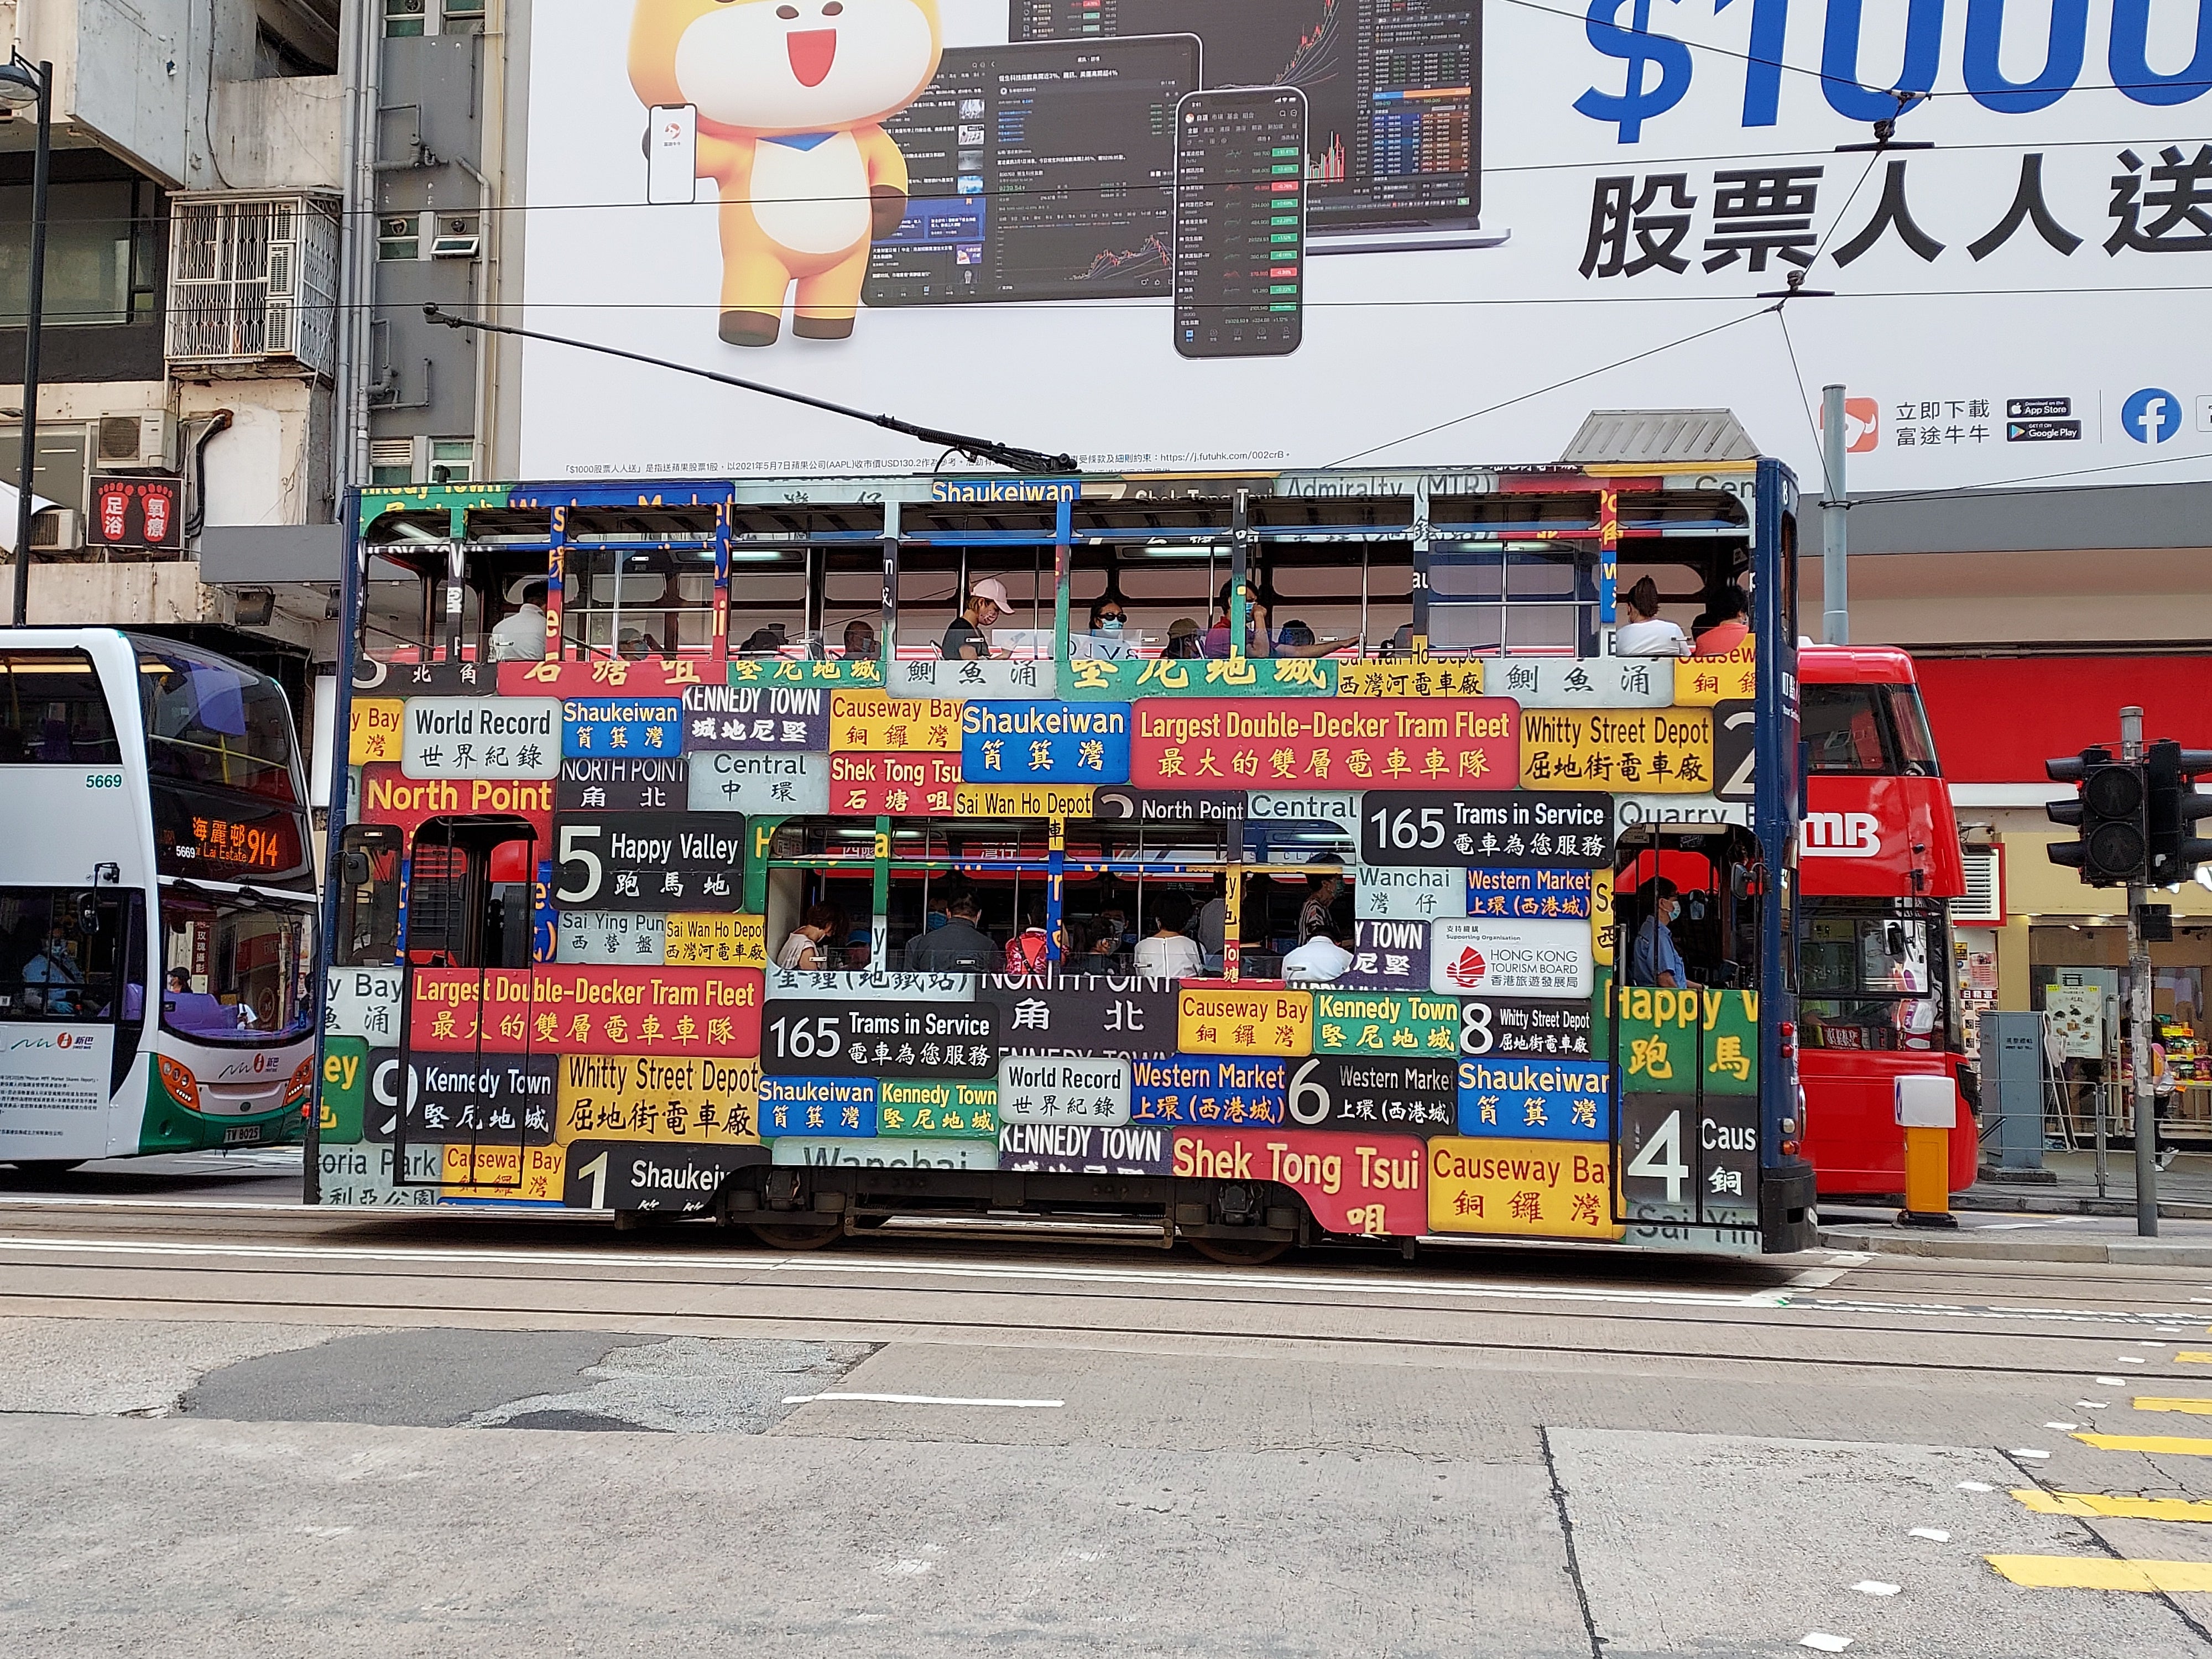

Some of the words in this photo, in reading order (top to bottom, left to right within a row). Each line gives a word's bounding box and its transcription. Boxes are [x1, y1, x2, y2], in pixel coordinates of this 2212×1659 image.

[1578, 145, 2212, 280] 股票人人送
[1896, 399, 1990, 421] 立即下載
[2025, 406, 2042, 415] App
[1896, 424, 1990, 446] 富途牛牛
[2028, 429, 2059, 439] Google
[2060, 427, 2077, 437] Play
[932, 482, 1073, 502] Shaukeiwan
[562, 701, 677, 722] Shaukeiwan
[682, 685, 761, 713] KENNEDY
[769, 687, 821, 716] TOWN
[832, 696, 921, 721] Causeway
[930, 698, 962, 721] Bay
[368, 708, 400, 732] Bay
[415, 709, 473, 735] World
[479, 709, 551, 735] Record
[962, 706, 1124, 734] Shaukeiwan
[1141, 712, 1220, 744] Largest
[1227, 711, 1390, 739] Double-Decker
[1395, 711, 1448, 738] Tram
[1455, 711, 1510, 738] Fleet
[1525, 716, 1581, 748] Whitty
[1590, 716, 1646, 744] Street
[1654, 716, 1709, 749] Depot
[366, 734, 386, 758] 灣
[576, 726, 664, 750] 筲箕灣
[846, 723, 949, 749] 銅鑼灣
[419, 743, 543, 770] 世界紀錄
[713, 753, 807, 776] Central
[981, 739, 1104, 771] 筲箕灣
[1158, 746, 1491, 780] 最大的雙層電車車隊
[1525, 750, 1708, 784] 屈地街電車廠
[85, 774, 122, 789] 5669
[561, 759, 627, 782] NORTH
[631, 759, 684, 783] POINT
[831, 758, 876, 782] Shek
[883, 759, 925, 787] Tong
[367, 780, 458, 811] North
[471, 780, 552, 811] Point
[721, 779, 797, 803] 中環
[844, 789, 952, 812] 石塘咀
[957, 792, 979, 815] Sai
[985, 793, 1015, 815] Wan
[1021, 793, 1041, 814] Ho
[1047, 792, 1091, 818] Depot
[1142, 800, 1193, 820] North
[1199, 800, 1244, 820] Point
[1251, 794, 1358, 818] Central
[1453, 802, 1507, 825] Trams
[1513, 802, 1528, 825] in
[1535, 802, 1604, 826] Service
[1370, 807, 1446, 850] 165
[1800, 812, 1881, 858] MB
[175, 845, 196, 858] 5669
[247, 829, 278, 866] 914
[611, 833, 672, 864] Happy
[679, 833, 739, 864] Valley
[1452, 832, 1606, 858] 電車為您服務
[555, 825, 602, 904] 5
[1358, 867, 1449, 888] Wanchai
[614, 871, 731, 898] 跑馬地
[1468, 870, 1531, 890] Western
[1537, 870, 1591, 891] Market
[1369, 891, 1438, 915] 灣仔
[562, 912, 588, 929] Sai
[594, 914, 628, 932] Ying
[635, 914, 664, 931] Pun
[666, 921, 684, 938] Sai
[687, 921, 711, 938] Wan
[714, 922, 729, 938] Ho
[733, 922, 765, 941] Depot
[572, 934, 654, 954] 西營盤
[1371, 921, 1423, 950] TOWN
[1490, 949, 1533, 961] HONG
[1536, 950, 1578, 962] KONG
[1490, 963, 1538, 973] TOURISM
[1540, 964, 1578, 974] BOARD
[355, 973, 403, 1003] Bay
[416, 975, 489, 1007] Largest
[495, 976, 645, 1005] Double-Decker
[650, 979, 702, 1006] Tram
[705, 980, 754, 1007] Fleet
[1490, 975, 1578, 988] 香港旅遊發展局
[1183, 997, 1269, 1022] Causeway
[1276, 999, 1308, 1024] Bay
[1319, 995, 1401, 1024] Kennedy
[1408, 997, 1458, 1021] Town
[1500, 1009, 1529, 1030] Whitty
[1532, 1010, 1560, 1028] Street
[1562, 1011, 1590, 1031] Depot
[848, 1011, 900, 1035] Trams
[905, 1013, 919, 1035] in
[925, 1014, 990, 1036] Service
[1194, 1024, 1295, 1048] 銅鑼灣
[1459, 1003, 1494, 1055] 8
[769, 1016, 841, 1058] 165
[1322, 1024, 1455, 1051] 堅尼地城
[847, 1041, 992, 1067] 電車為您服務
[1628, 1034, 1751, 1081] 跑馬
[425, 1066, 500, 1098] Kennedy
[507, 1068, 551, 1095] Town
[569, 1056, 628, 1095] Whitty
[636, 1061, 692, 1092] Street
[702, 1060, 759, 1098] Depot
[1008, 1065, 1057, 1089] World
[1062, 1066, 1121, 1090] Record
[1133, 1062, 1210, 1088] Western
[1218, 1065, 1285, 1091] Market
[1339, 1065, 1399, 1090] Western
[1405, 1067, 1455, 1092] Market
[758, 1080, 874, 1102] Shaukeiwan
[882, 1084, 950, 1108] Kennedy
[955, 1085, 998, 1105] Town
[1288, 1058, 1331, 1125] 6
[566, 1098, 756, 1138] 屈地街電車廠
[772, 1106, 860, 1130] 筲箕灣
[1013, 1095, 1116, 1118] 世界紀錄
[1478, 1094, 1597, 1129] 筲箕灣
[883, 1109, 995, 1132] 堅尼地城
[999, 1125, 1092, 1158] KENNEDY
[1100, 1127, 1161, 1162] TOWN
[1627, 1109, 1689, 1203] 4
[532, 1150, 563, 1175] Bay
[1172, 1137, 1254, 1179] Shek
[1266, 1142, 1342, 1195] Tong
[1355, 1146, 1419, 1190] Tsui
[1433, 1149, 1562, 1188] Causeway
[578, 1151, 608, 1209] 1
[1708, 1165, 1743, 1197] 銅
[1452, 1190, 1598, 1227] 銅鑼灣
